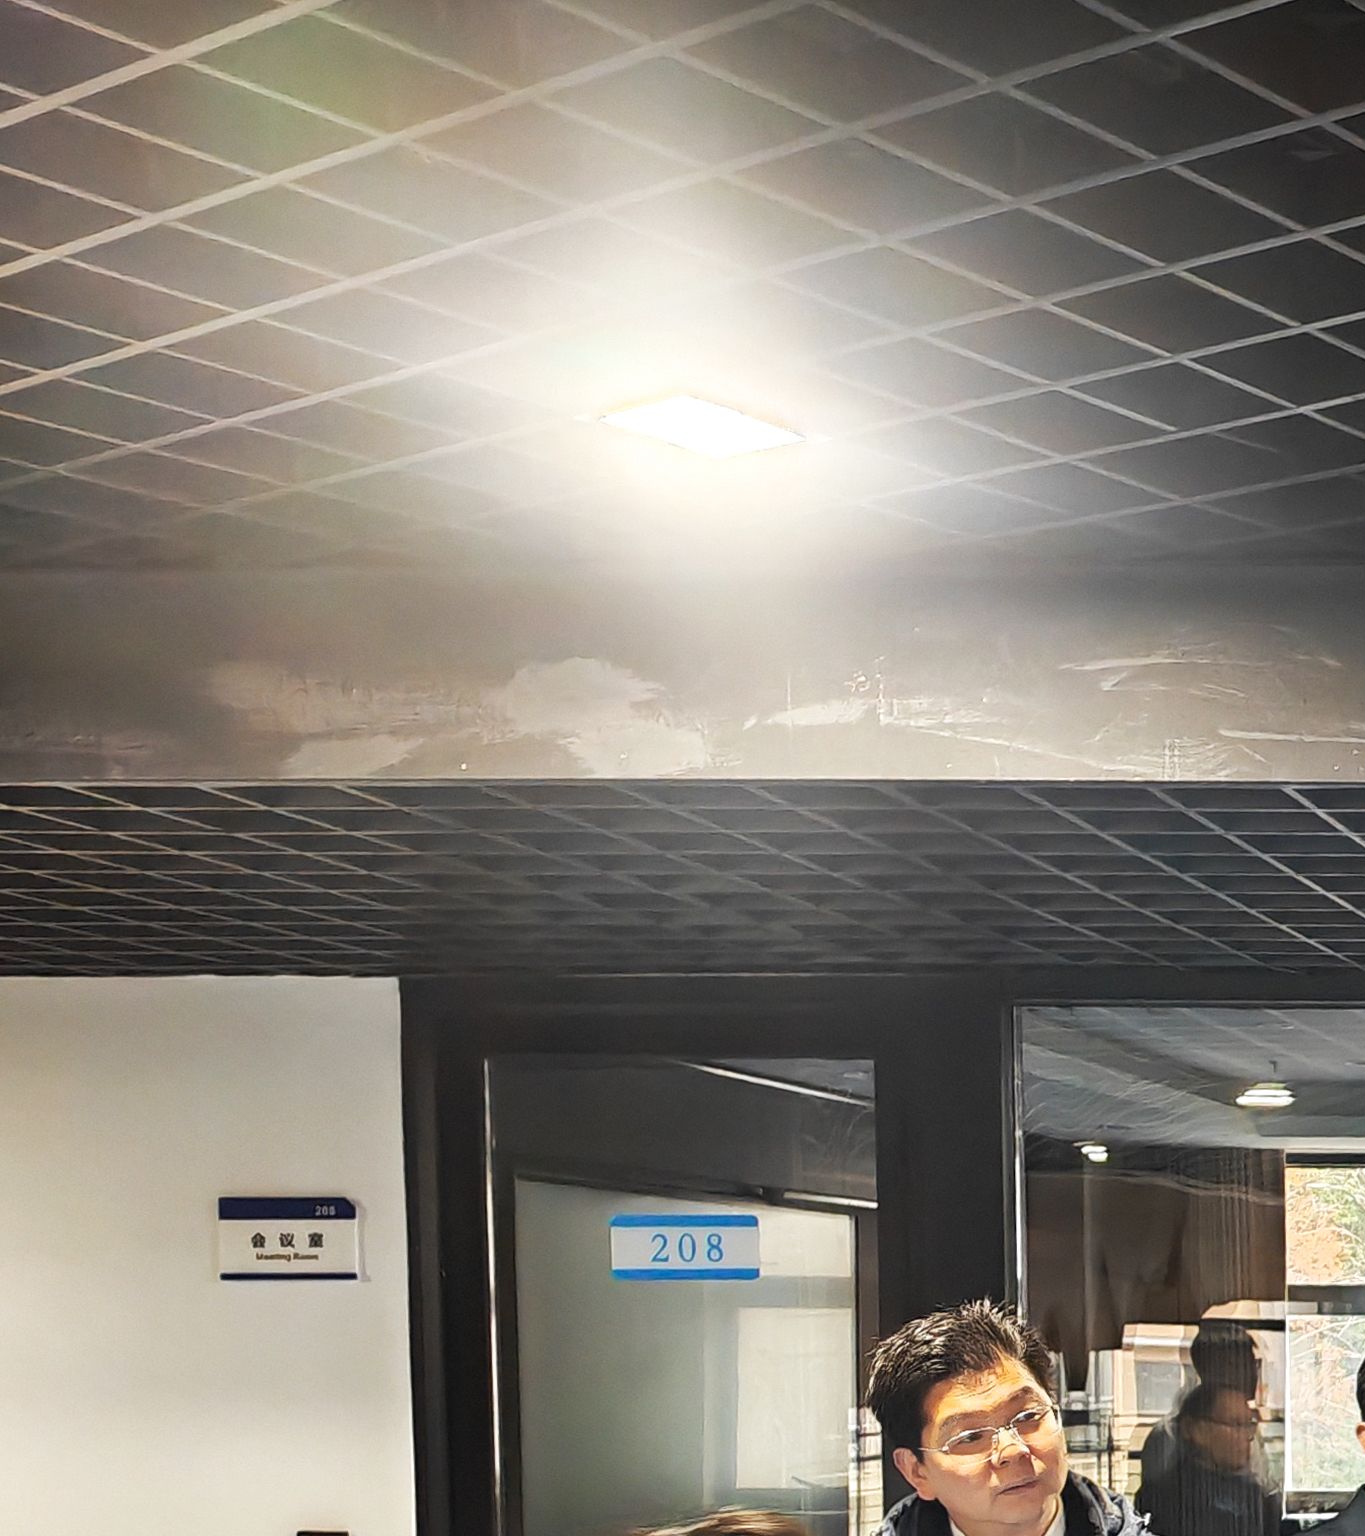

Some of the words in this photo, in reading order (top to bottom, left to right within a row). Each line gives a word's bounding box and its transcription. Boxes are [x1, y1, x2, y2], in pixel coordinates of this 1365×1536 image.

[251, 1232, 324, 1249] 会议室
[651, 1233, 724, 1263] 208
